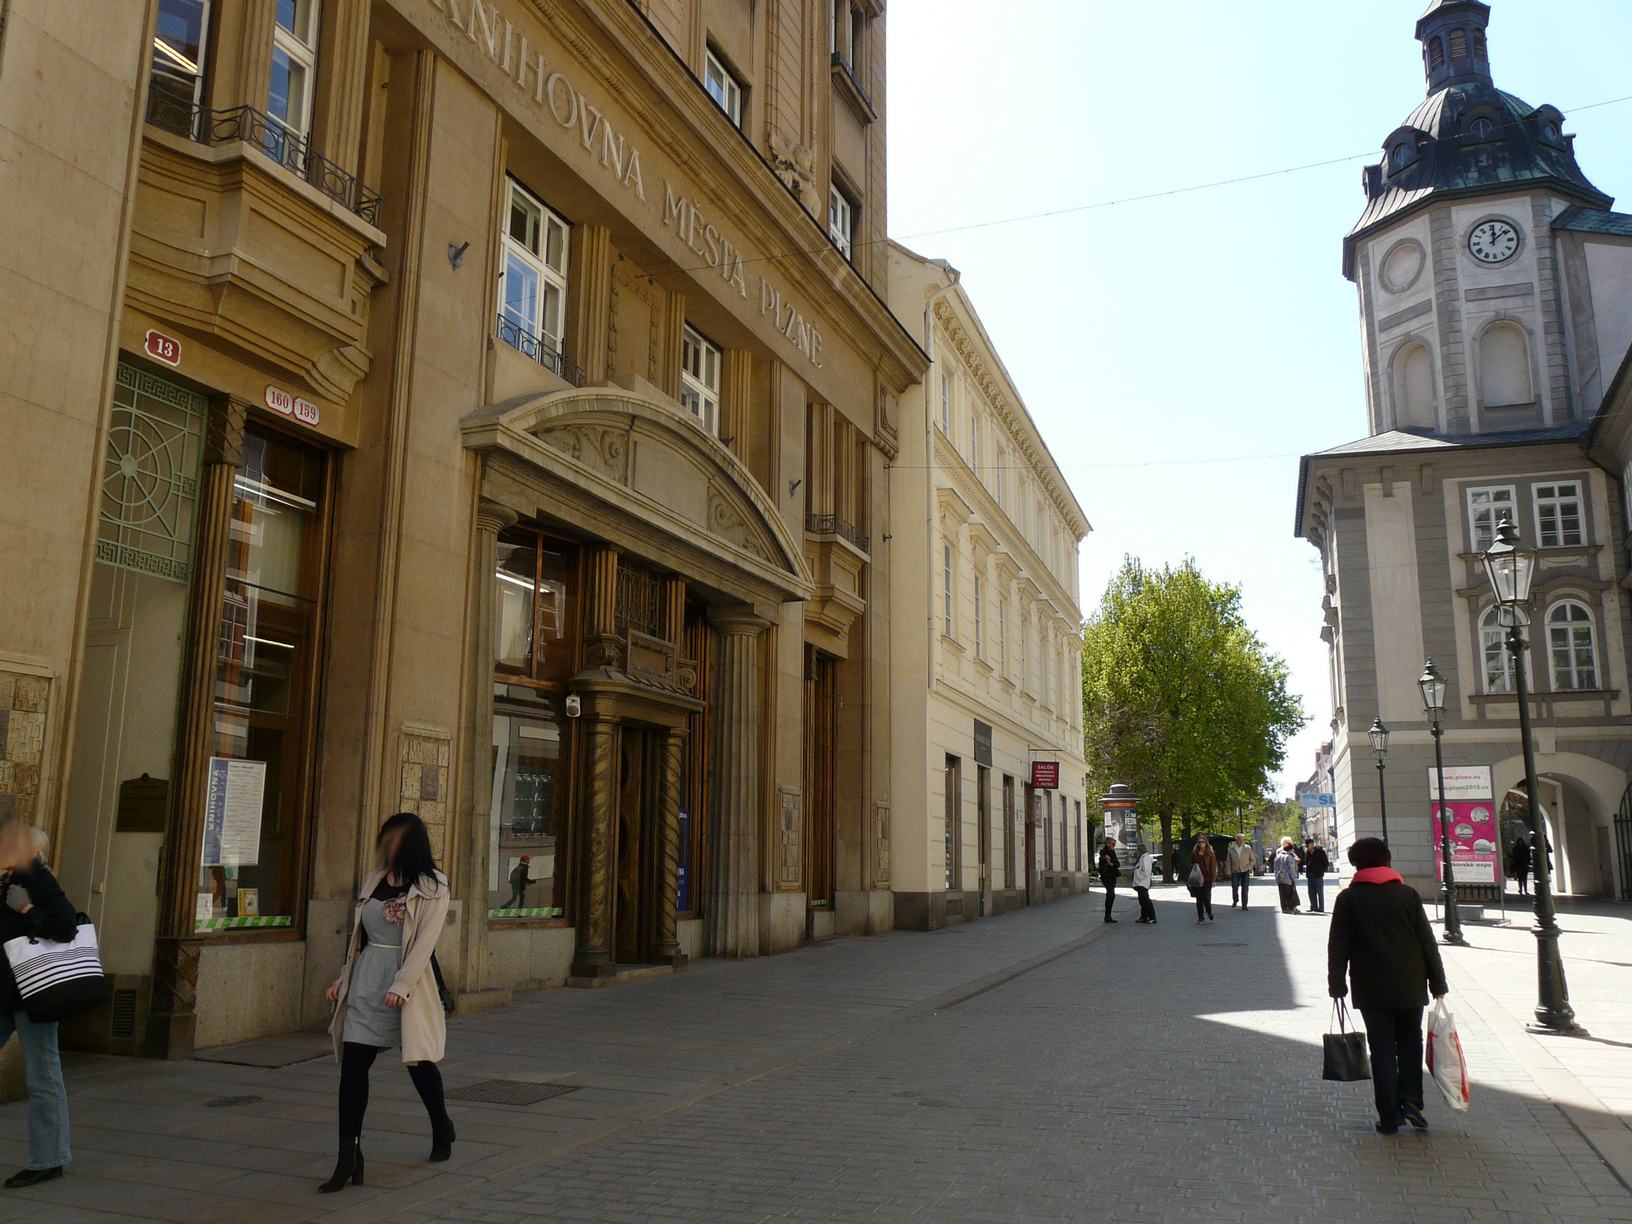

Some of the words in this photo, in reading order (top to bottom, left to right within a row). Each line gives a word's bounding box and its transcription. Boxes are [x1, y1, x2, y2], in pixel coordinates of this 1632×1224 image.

[663, 179, 747, 300] MĚSTA
[758, 276, 824, 369] PLZNĚ
[156, 337, 174, 357] 13
[270, 390, 289, 409] 160
[299, 401, 316, 424] 159
[207, 769, 219, 831] KNIHOVNA
